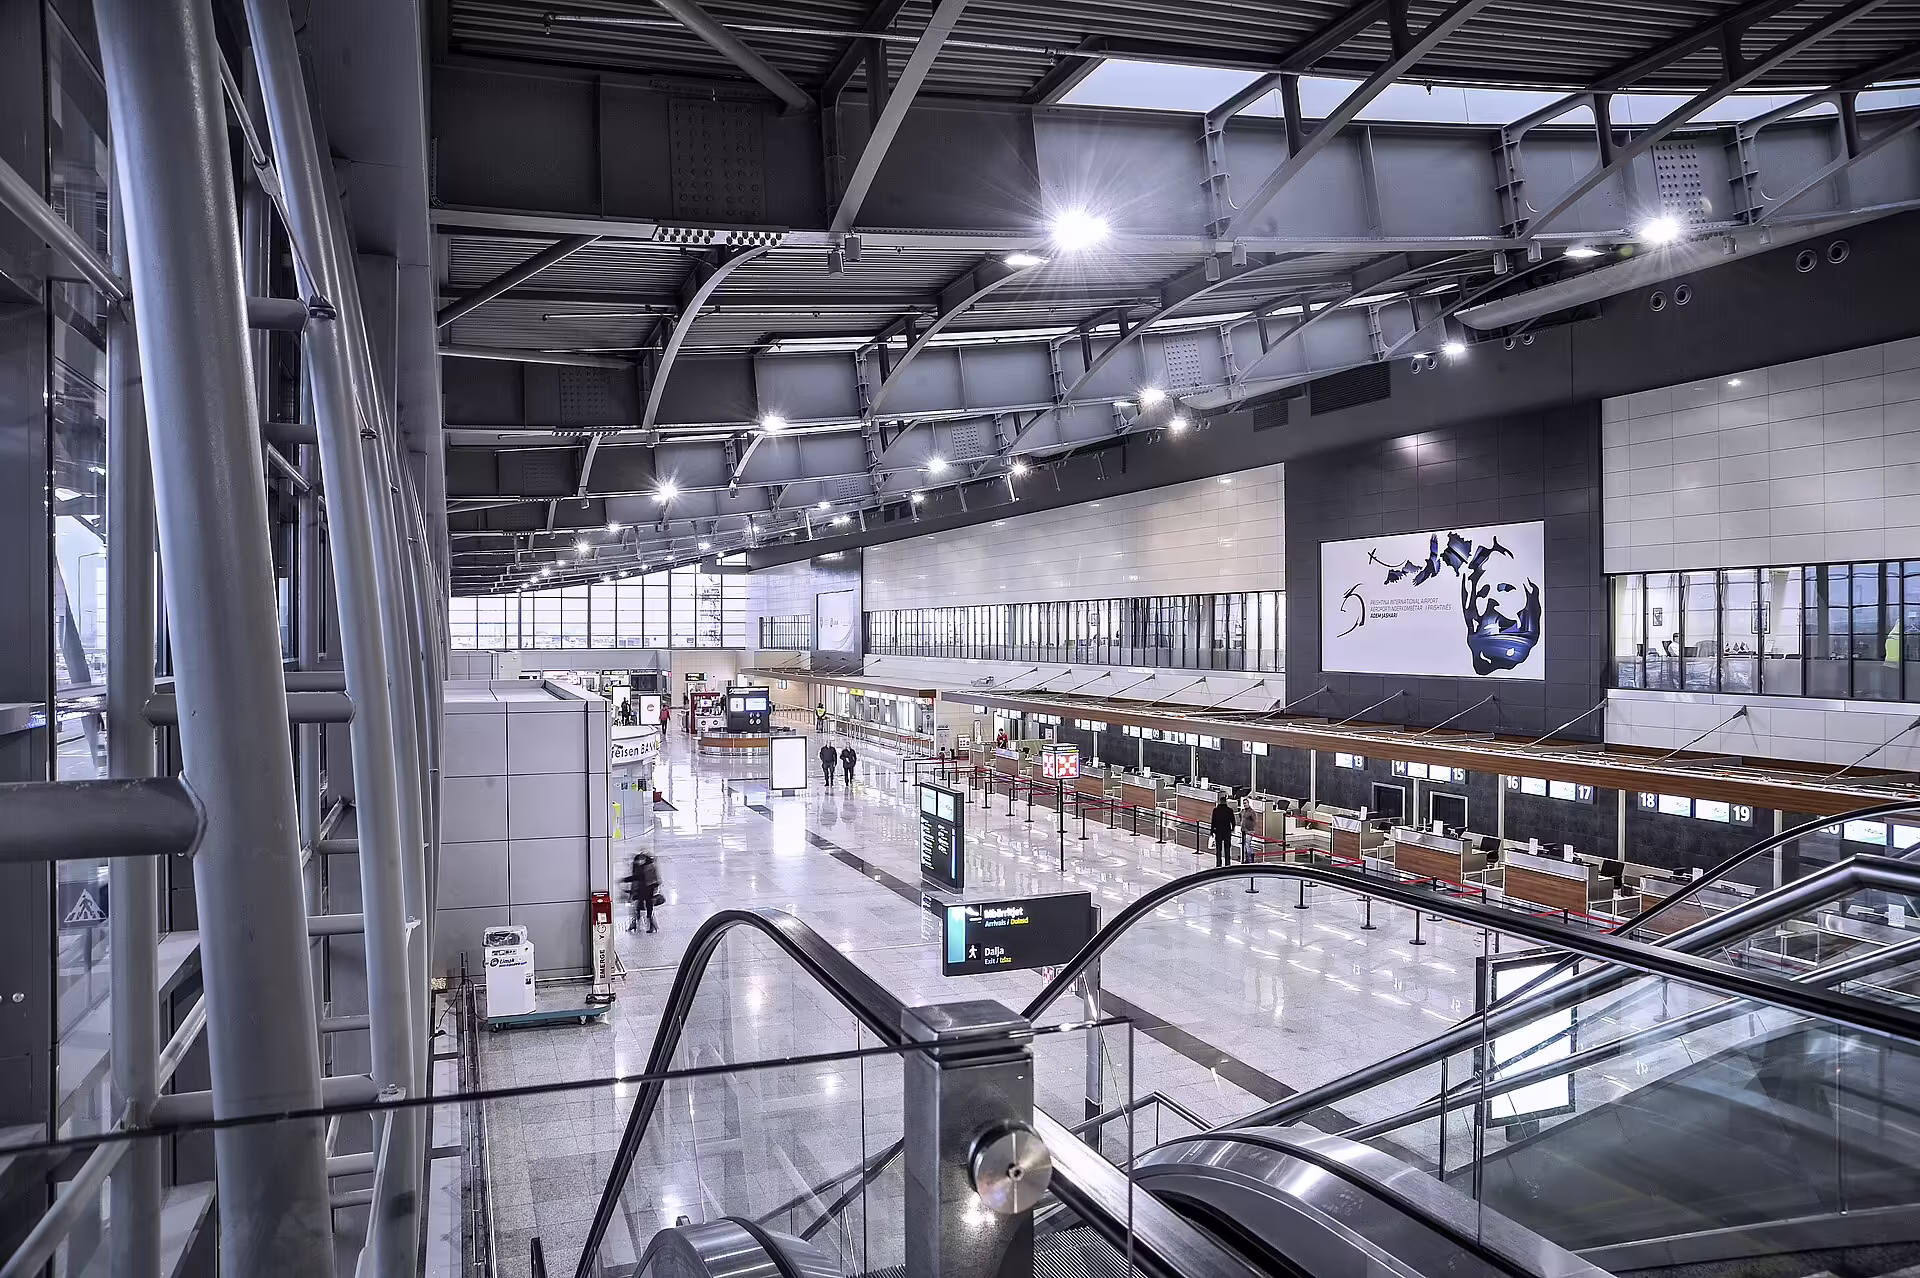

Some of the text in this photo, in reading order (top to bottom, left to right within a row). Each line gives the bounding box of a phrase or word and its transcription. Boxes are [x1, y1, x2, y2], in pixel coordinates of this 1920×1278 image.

[1389, 598, 1420, 606] INTERNATIONAL
[1395, 761, 1405, 774] 14
[1452, 767, 1464, 781] 15
[1506, 775, 1519, 789] 16
[1578, 785, 1591, 799] 17
[1640, 792, 1655, 808] 18
[1732, 805, 1751, 822] 19
[984, 919, 1007, 928] Arrivals
[984, 946, 1005, 958] Dalja
